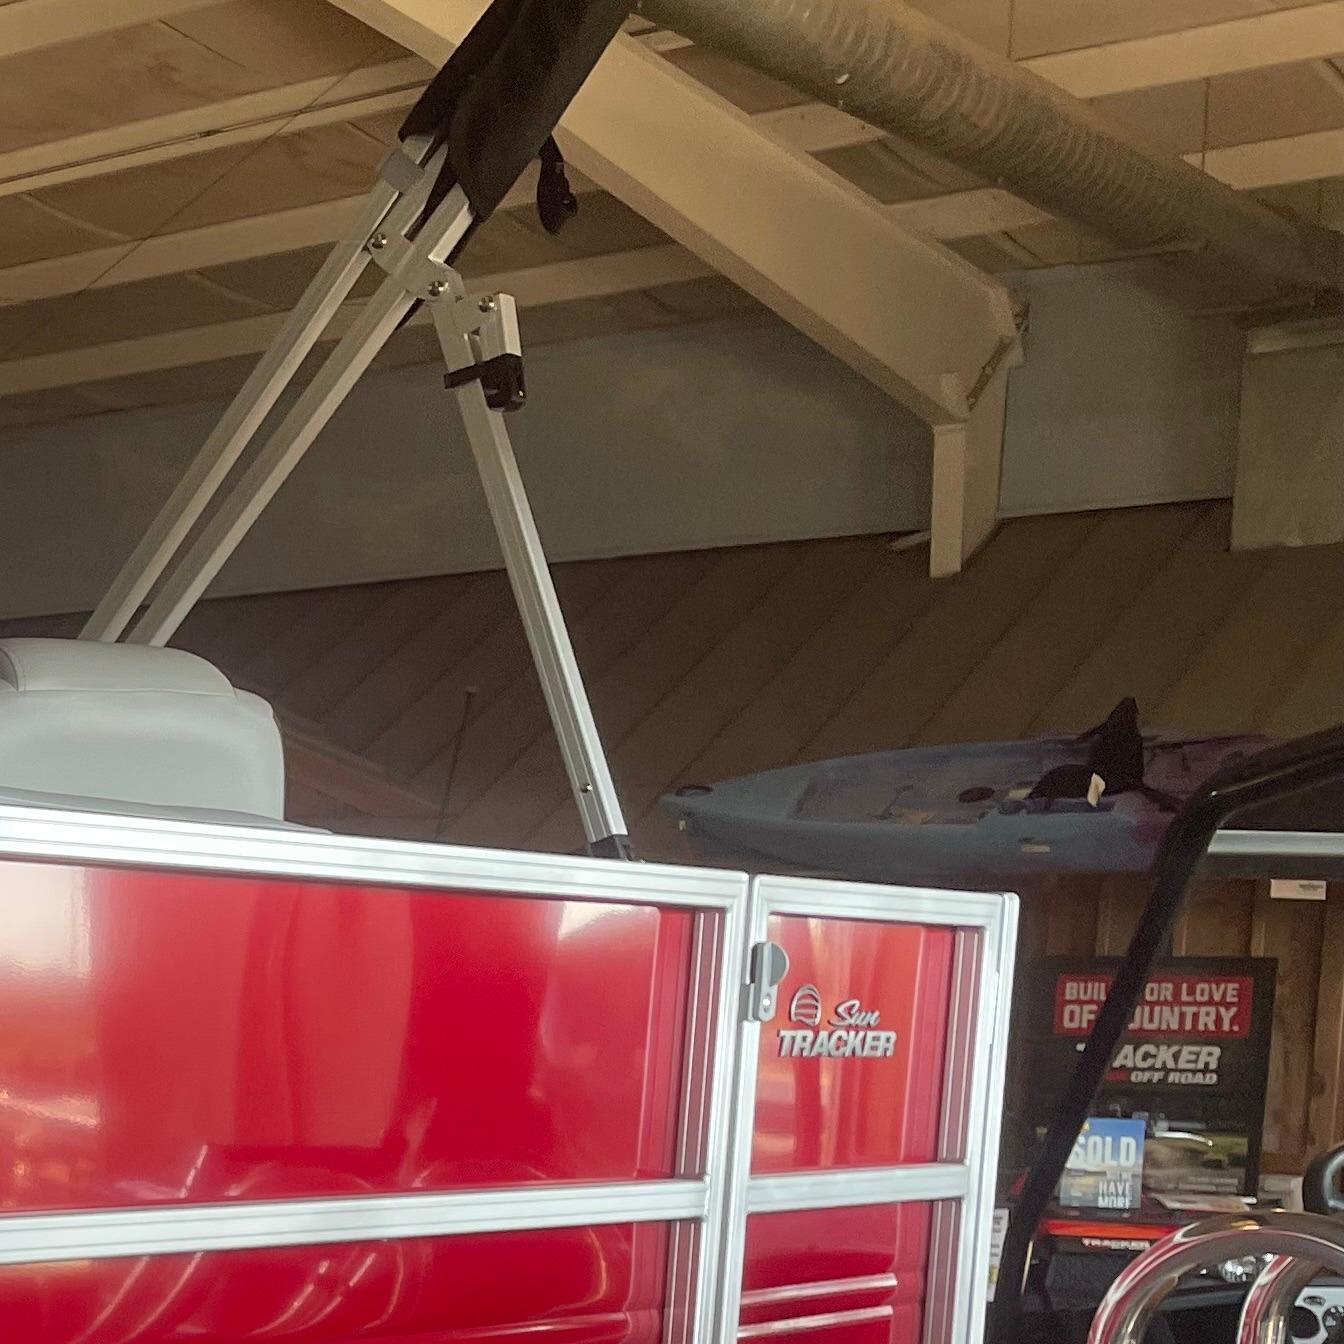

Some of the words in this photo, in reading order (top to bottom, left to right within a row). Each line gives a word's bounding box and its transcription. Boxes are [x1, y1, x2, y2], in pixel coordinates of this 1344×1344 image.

[1064, 981, 1108, 1001] BUIL
[1144, 982, 1174, 1002] OR
[1180, 982, 1240, 1003] LOVE
[828, 998, 881, 1029] Sun
[1062, 1003, 1099, 1030] OF
[1127, 1004, 1240, 1032] UNTRY.
[777, 1029, 897, 1058] TRACKER
[1112, 1043, 1222, 1071] ACKER
[1129, 1070, 1166, 1084] OFF
[1167, 1071, 1218, 1085] ROAD
[1072, 1135, 1137, 1168] SOLD
